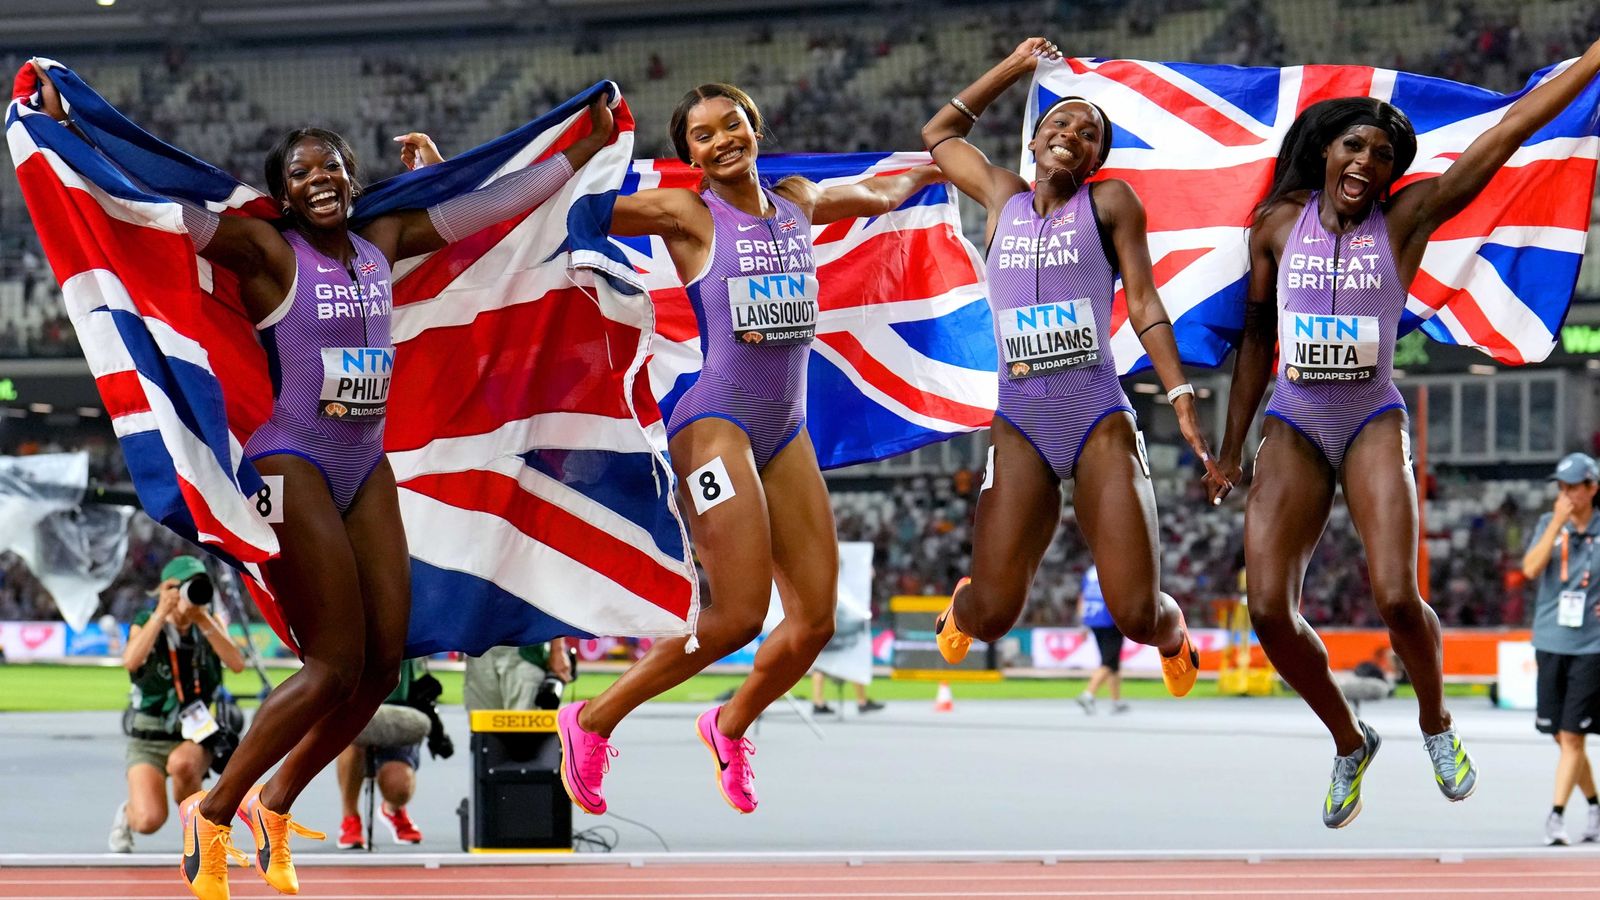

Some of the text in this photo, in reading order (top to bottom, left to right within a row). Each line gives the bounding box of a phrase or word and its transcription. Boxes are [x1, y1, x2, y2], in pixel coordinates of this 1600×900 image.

[735, 235, 808, 255] GREAT
[1001, 230, 1076, 252] GREAT
[739, 253, 815, 272] BRITAIN
[999, 249, 1079, 269] BRITAIN
[1290, 254, 1380, 273] GREAT
[315, 280, 389, 300] GREAT
[748, 274, 805, 301] NTN
[1288, 272, 1382, 289] BRITAIN
[736, 301, 815, 328] LANSIQUOT
[1016, 302, 1077, 331] NTN
[766, 331, 807, 341] BUDAPEST
[1295, 315, 1359, 341] NTN
[1005, 327, 1093, 359] WILLIAMS
[1295, 342, 1359, 365] NEITA
[342, 349, 396, 374] NTN
[1032, 355, 1086, 371] BUDAPEST
[1302, 371, 1370, 381] BUDAPEST 23
[699, 471, 721, 501] 8
[256, 483, 272, 517] 8
[492, 714, 555, 728] SEIKO
